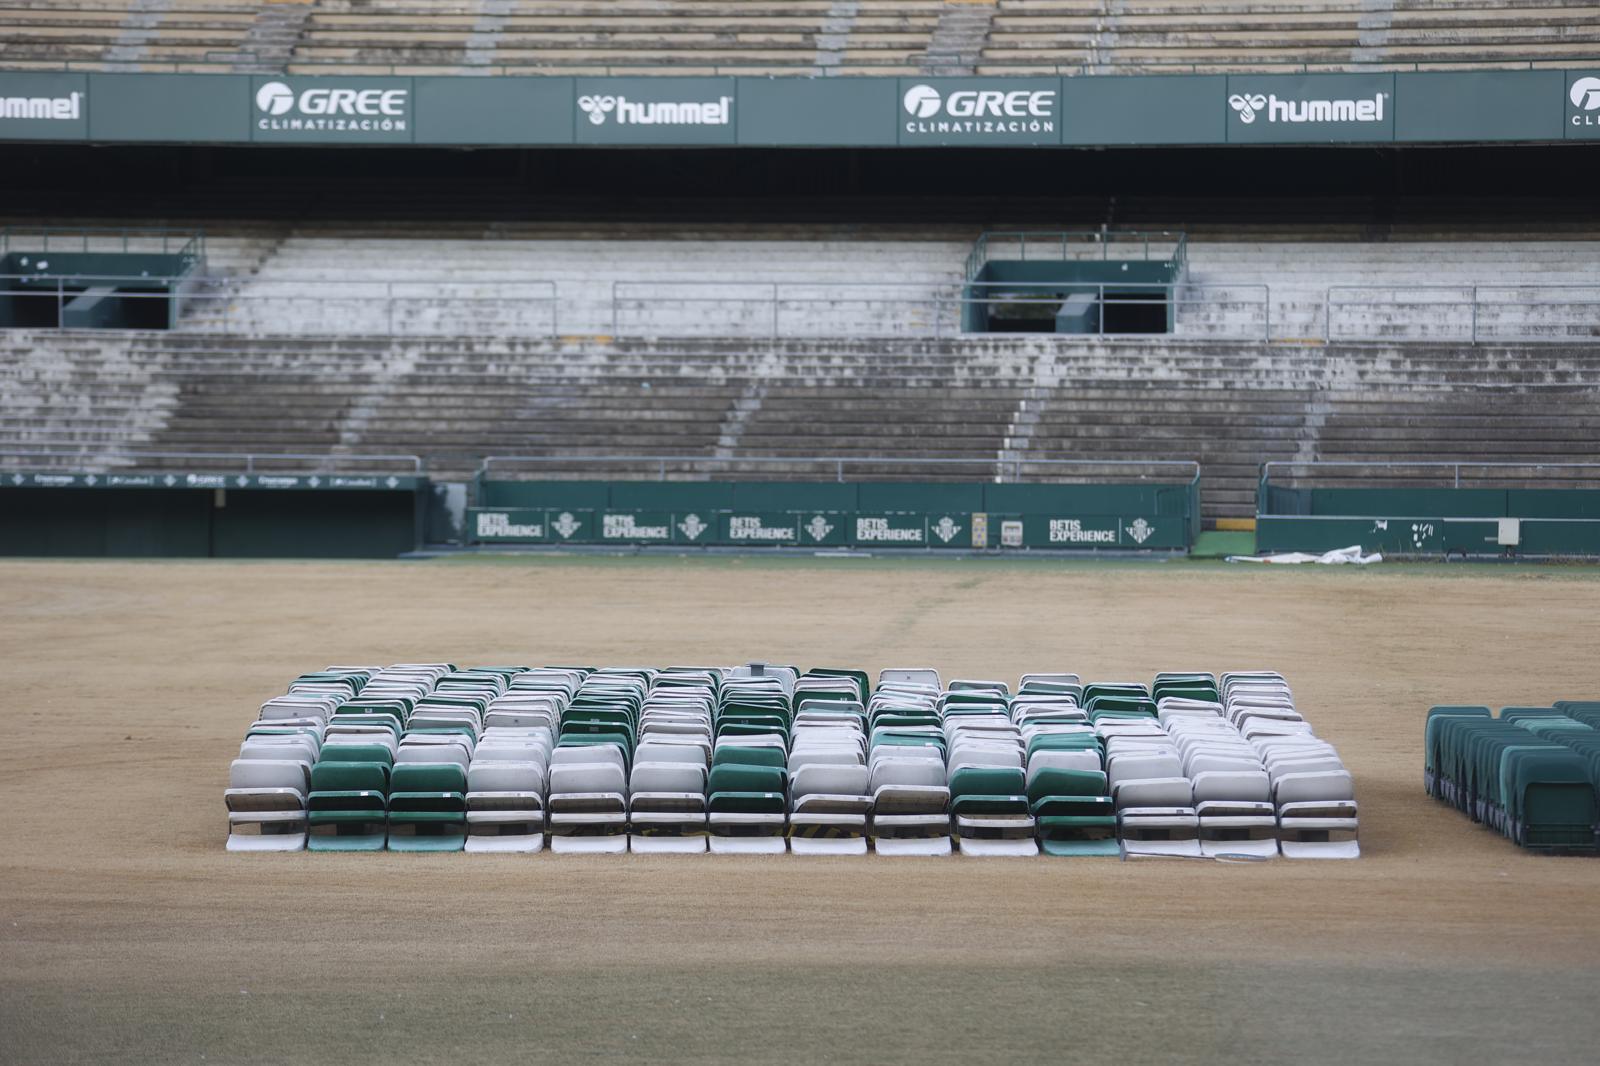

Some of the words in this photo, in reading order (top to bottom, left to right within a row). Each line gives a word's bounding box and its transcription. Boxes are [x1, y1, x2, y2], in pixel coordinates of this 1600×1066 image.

[0, 91, 79, 119] mmel
[298, 89, 408, 115] GREE
[946, 90, 1056, 116] GREE
[1268, 92, 1384, 122] hummel
[616, 96, 729, 124] hummel
[258, 118, 407, 131] CLIMATIZACIÓN
[906, 119, 1054, 132] CLIMATIZACIÓN
[857, 517, 888, 529] BETIS
[1049, 519, 1081, 531] BETIS
[857, 528, 922, 541] EXPERIENCE
[1049, 530, 1115, 542] EXPERIENCE
